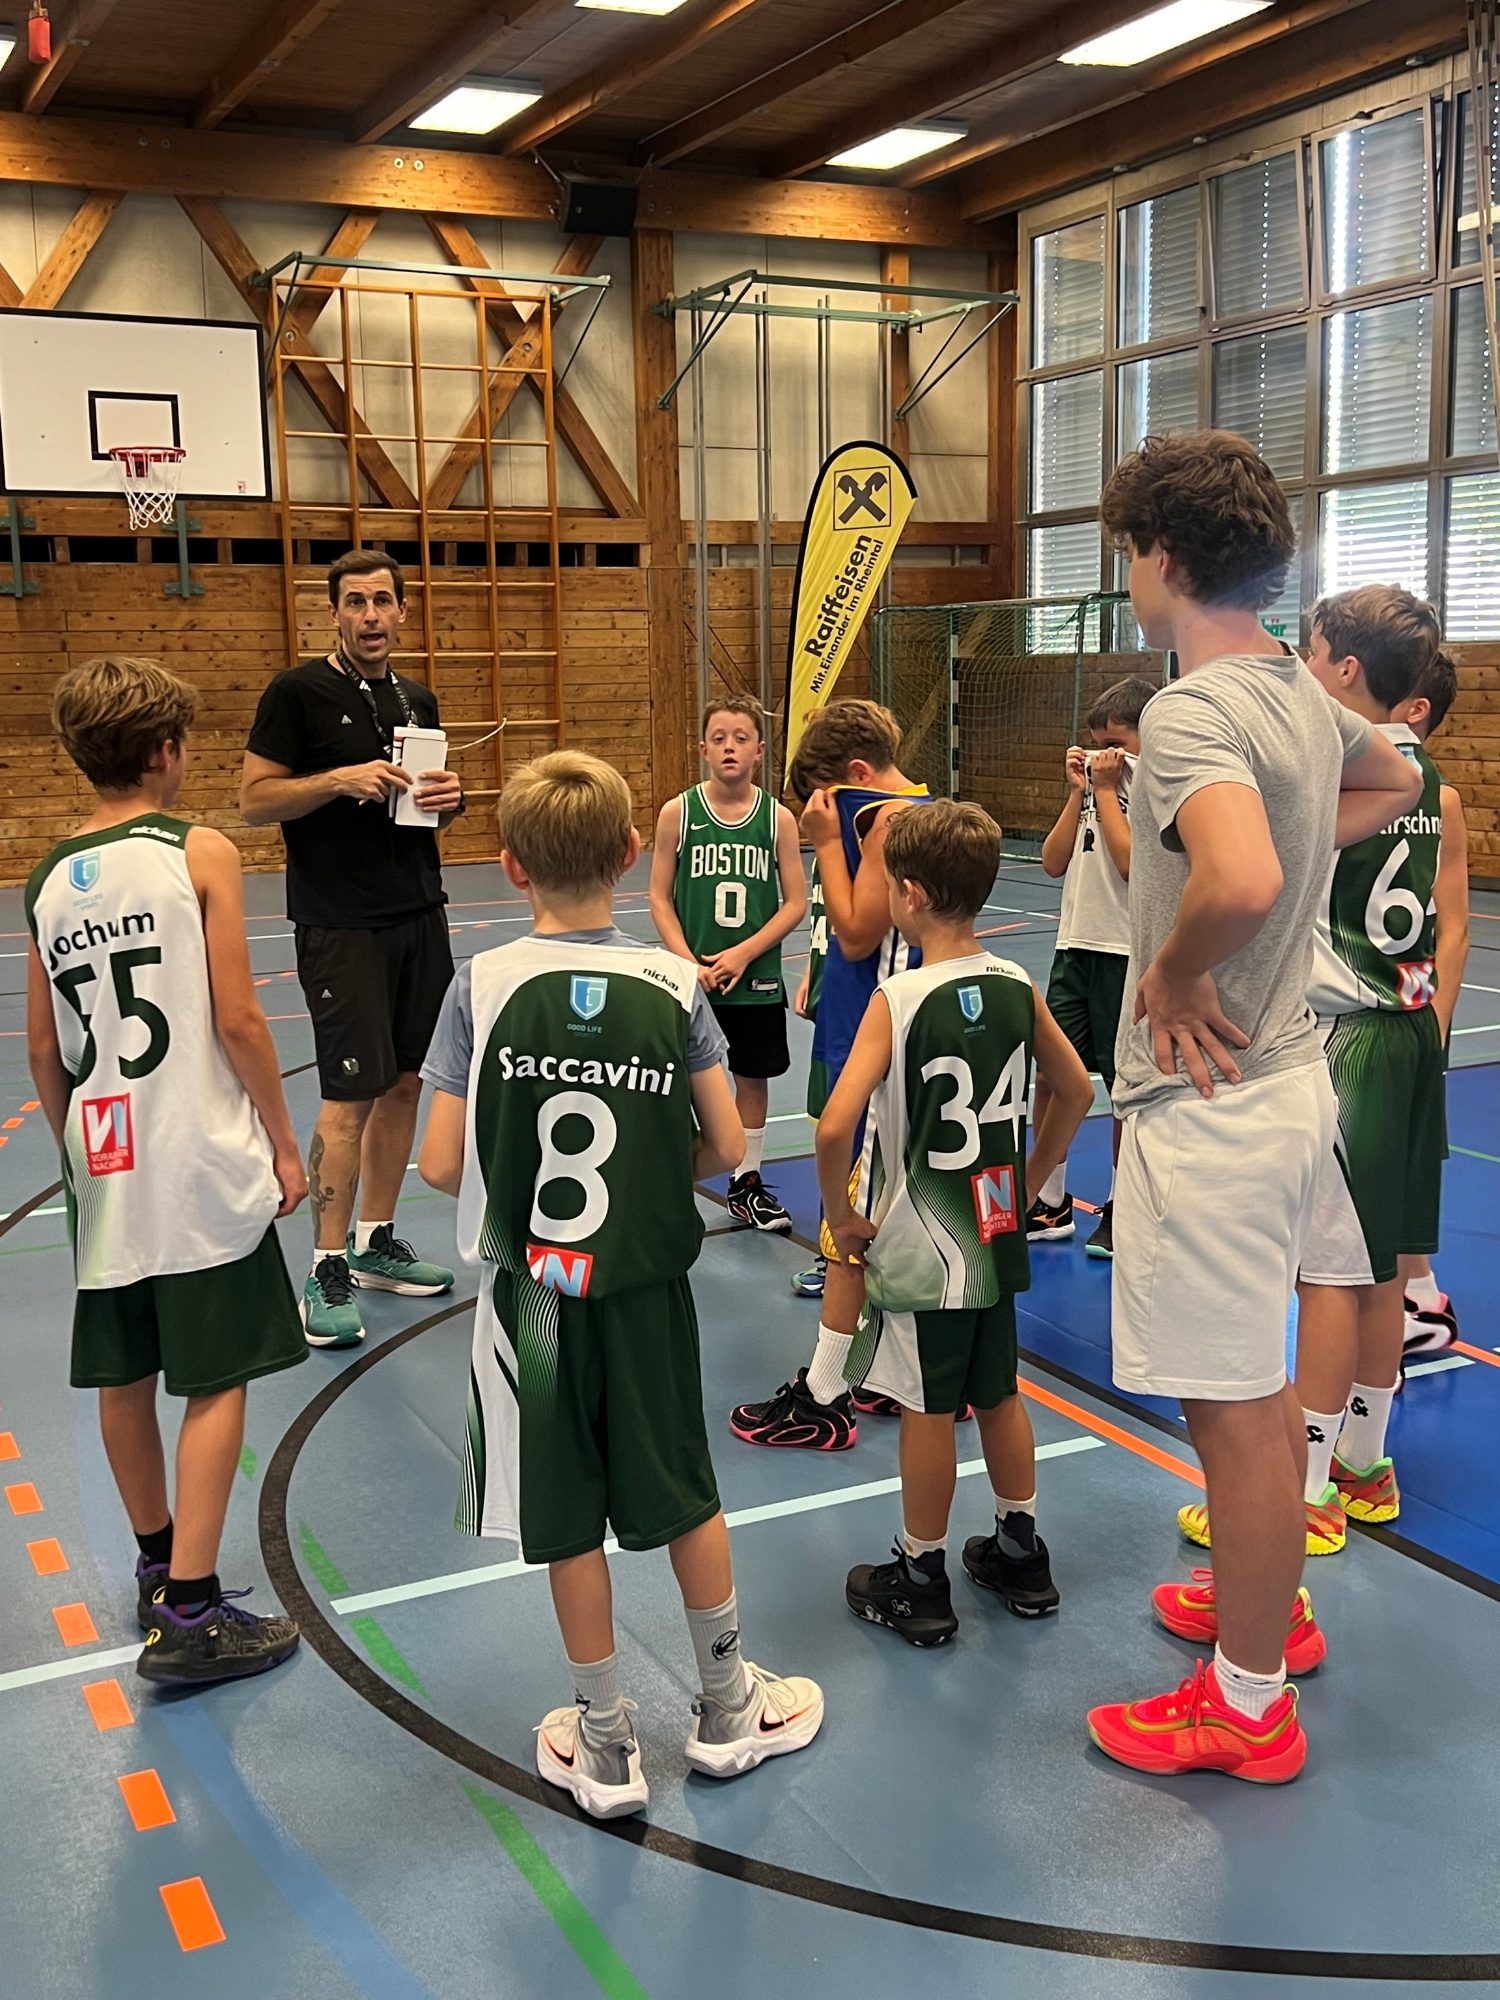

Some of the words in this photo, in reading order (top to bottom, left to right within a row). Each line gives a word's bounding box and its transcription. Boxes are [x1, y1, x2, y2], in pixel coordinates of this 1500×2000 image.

[804, 535, 872, 658] Raiffeisen
[810, 614, 851, 693] Mit.Einander
[855, 539, 884, 594] Rheintal
[691, 843, 769, 882] BOSTON
[715, 881, 747, 928] 0
[52, 946, 170, 1085] 55
[498, 1046, 675, 1096] Saccavini
[567, 1023, 587, 1032] GOOD
[587, 1026, 603, 1034] LIFE
[529, 1089, 618, 1244] 8
[921, 1040, 1027, 1171] 34
